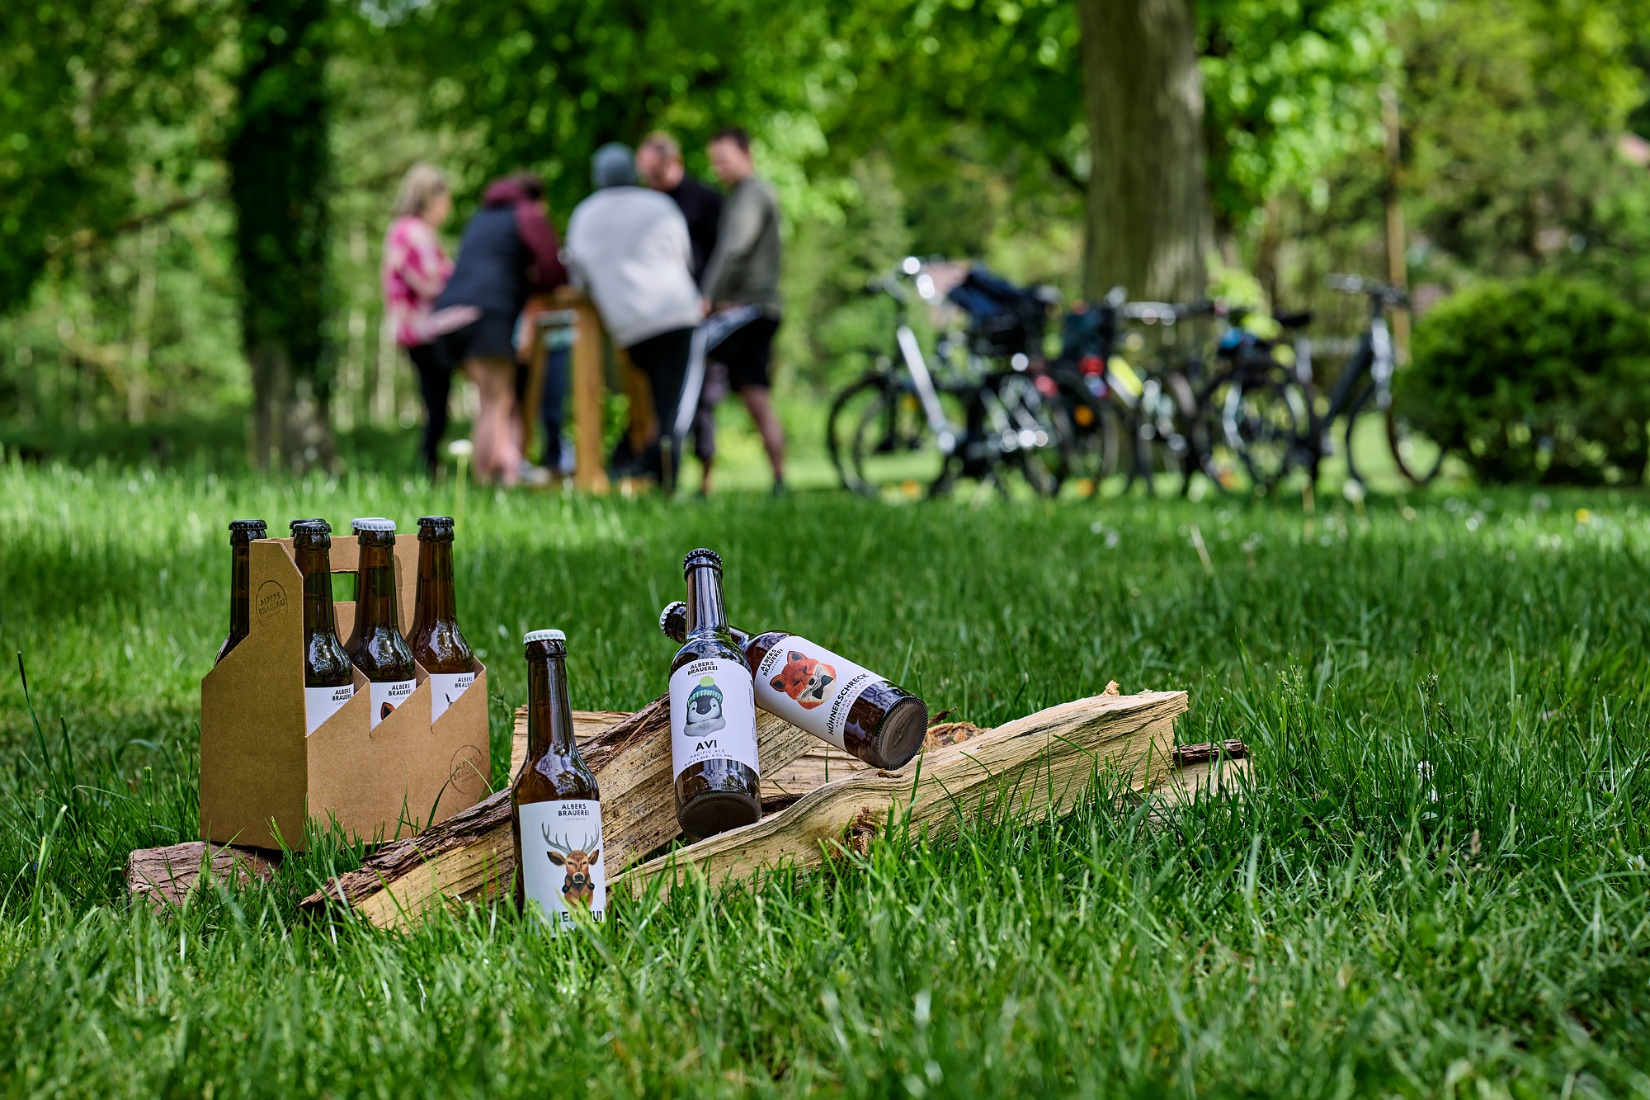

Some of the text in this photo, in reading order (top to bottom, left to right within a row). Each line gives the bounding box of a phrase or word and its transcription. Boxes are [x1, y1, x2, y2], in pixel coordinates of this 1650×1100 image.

[690, 661, 715, 669] ALBERS
[761, 649, 777, 671] ALBERS
[763, 648, 784, 677] BRAUEREI
[687, 666, 718, 675] BRAUEREI
[827, 673, 870, 736] HÜHNERSCHRECK
[696, 740, 717, 752] AVI
[558, 809, 590, 817] BRAUEREI
